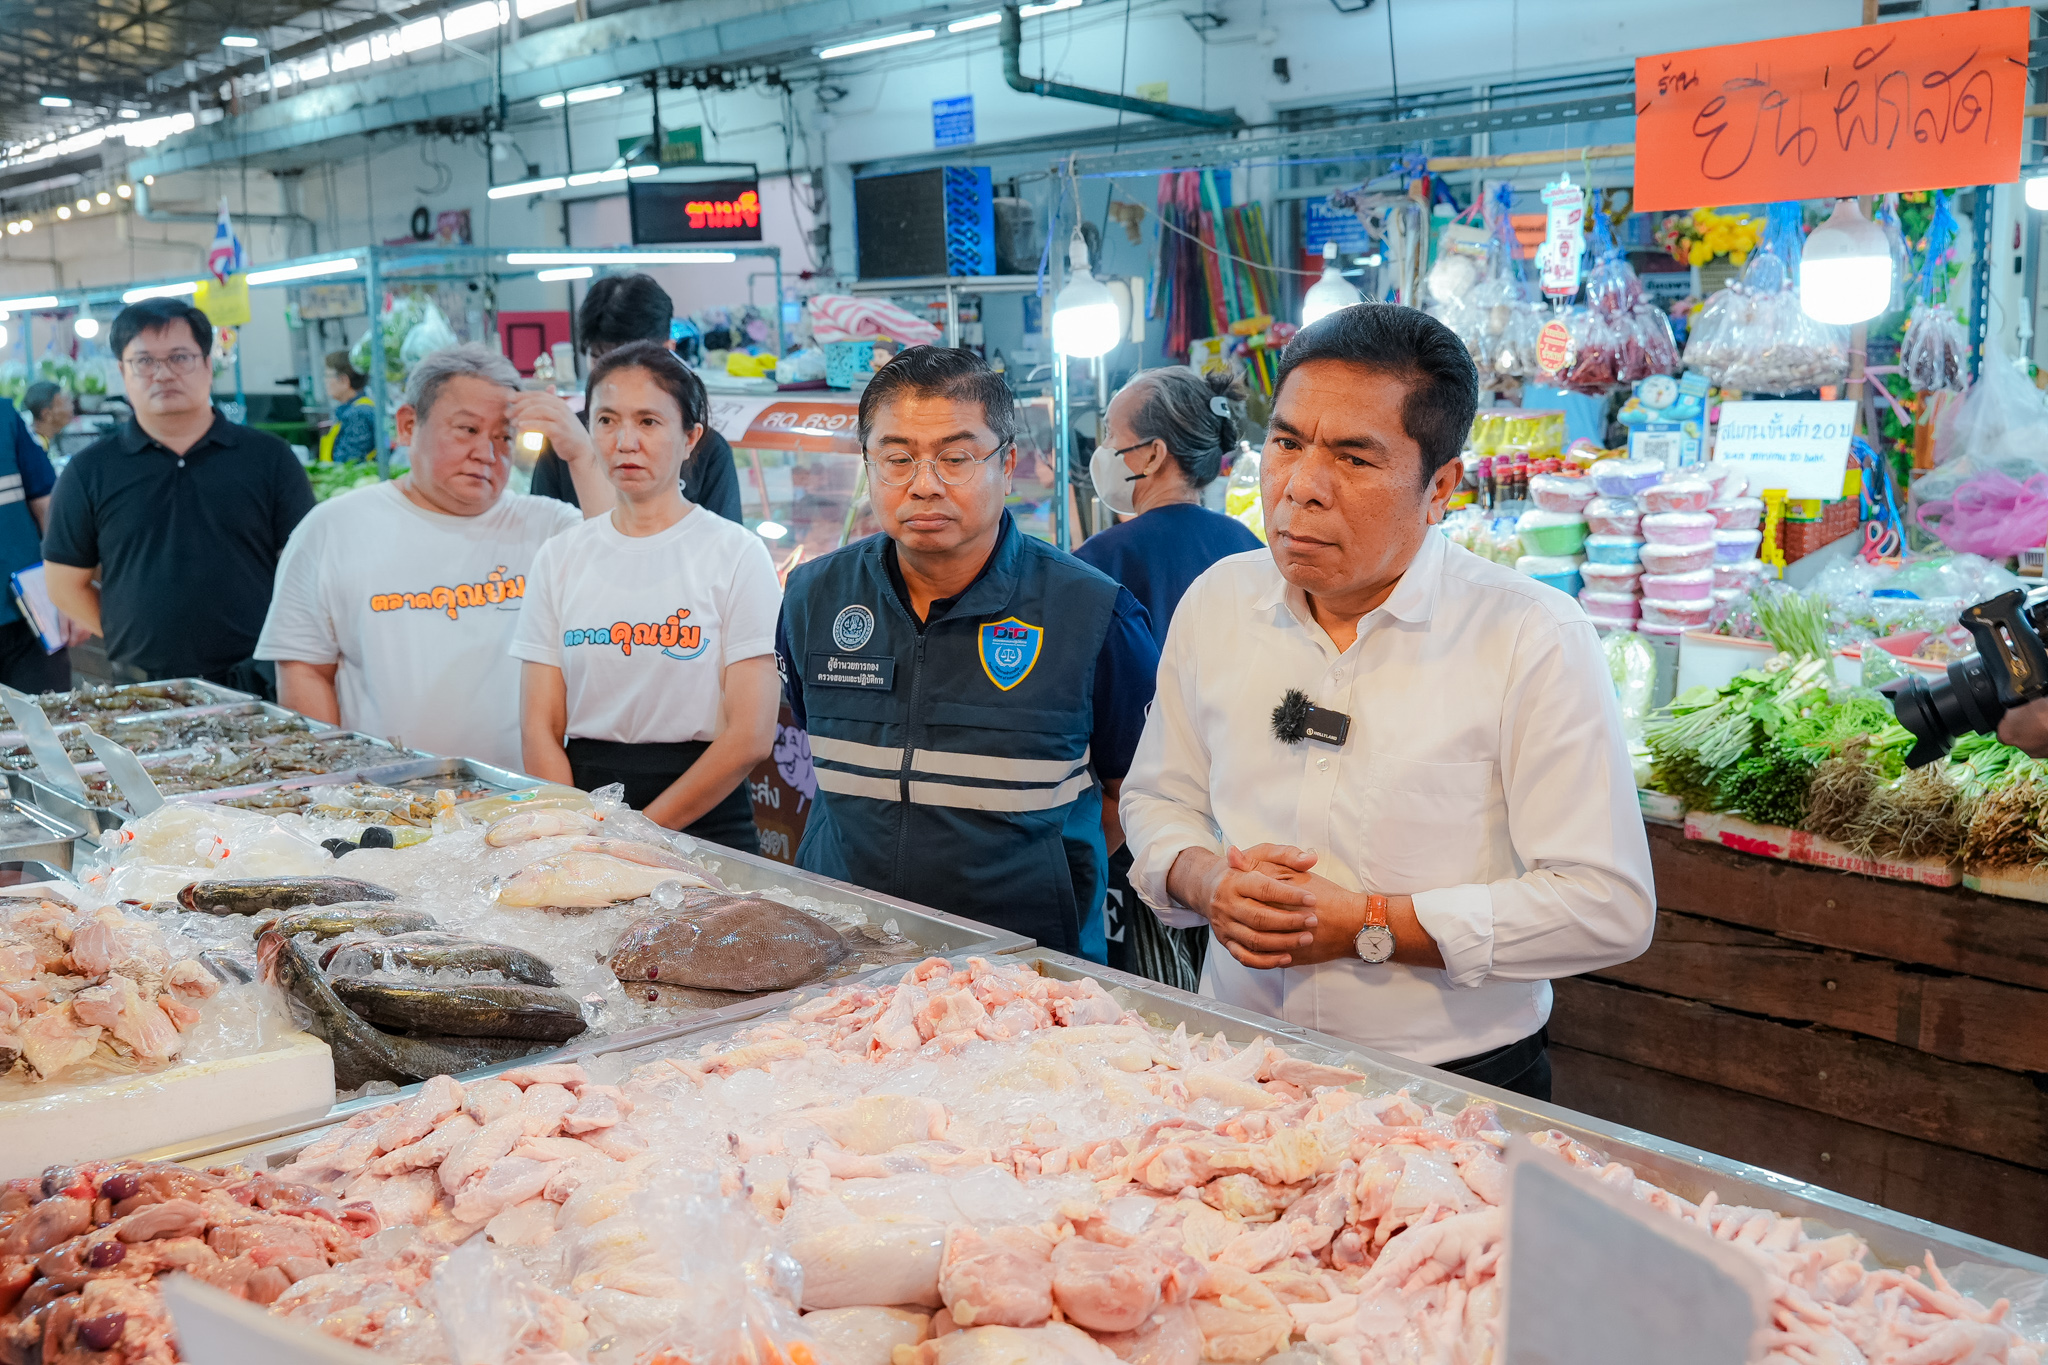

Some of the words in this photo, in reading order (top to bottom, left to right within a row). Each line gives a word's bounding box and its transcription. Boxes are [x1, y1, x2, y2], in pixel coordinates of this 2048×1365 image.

[1658, 60, 1699, 96] ร้าน
[762, 411, 799, 428] สด
[801, 412, 859, 430] สะอา
[371, 565, 526, 620] ตลาดคุณยิ้ม
[564, 608, 701, 656] ตลาดคุณยิ้ม
[827, 656, 879, 672] ผู้อำนวยการกอง
[1313, 731, 1337, 740] HOLLYLAND
